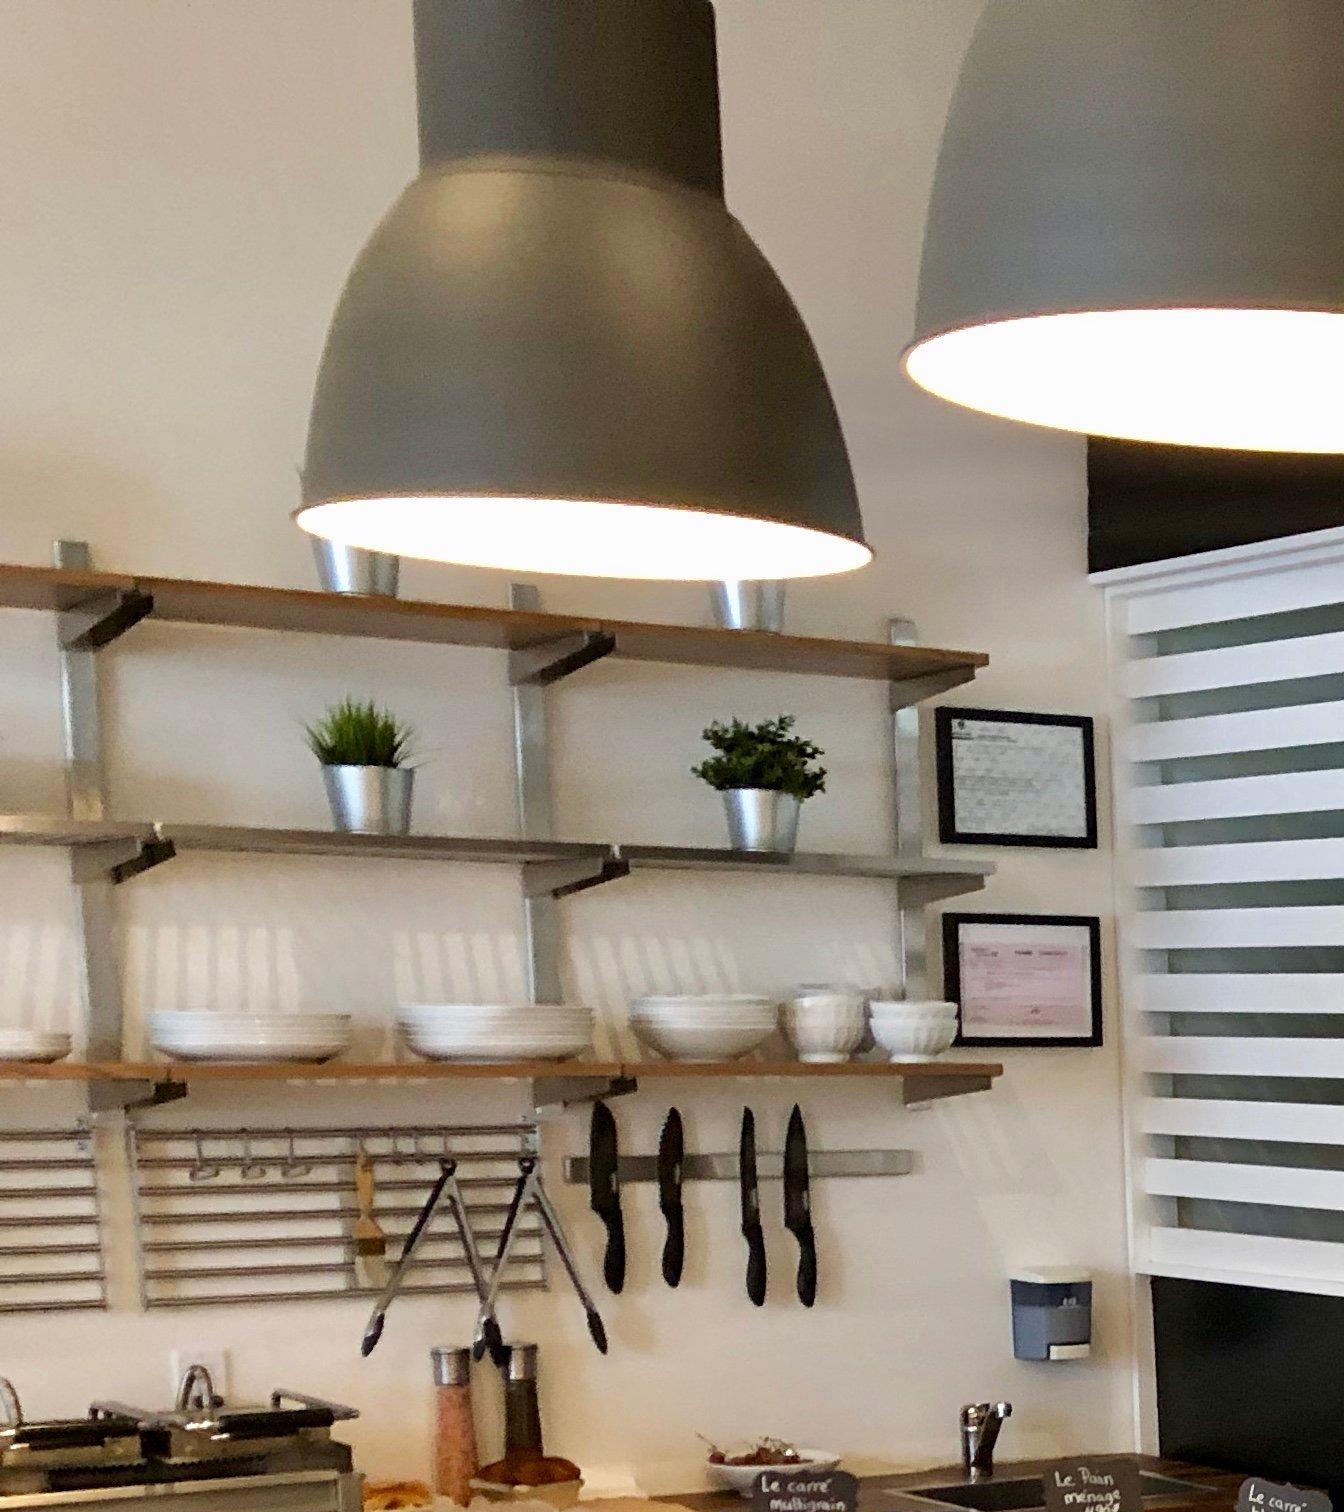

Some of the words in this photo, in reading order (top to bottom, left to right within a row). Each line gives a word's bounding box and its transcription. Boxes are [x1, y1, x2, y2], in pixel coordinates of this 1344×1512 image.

[761, 1475, 781, 1493] Le
[787, 1479, 833, 1493] carré
[1054, 1470, 1076, 1488] Le
[1248, 1484, 1265, 1505] Le
